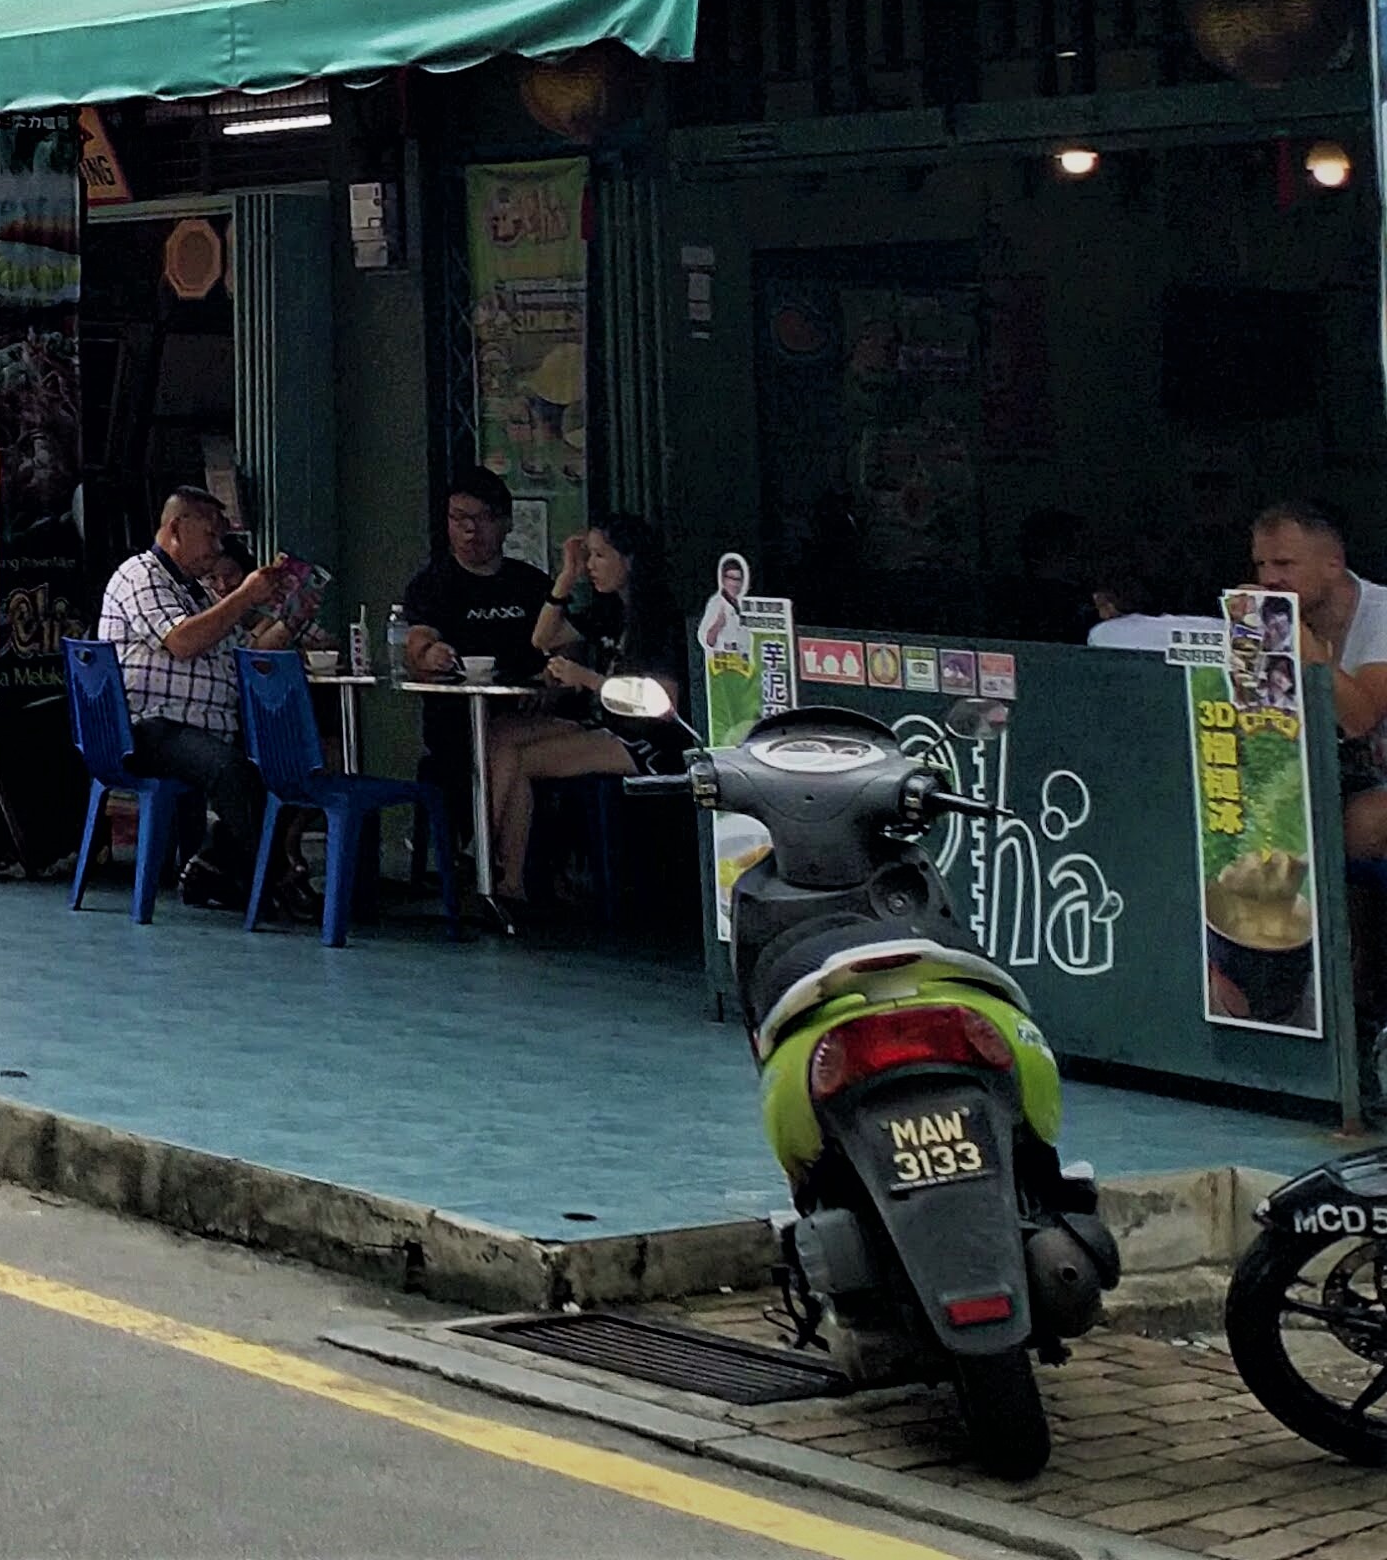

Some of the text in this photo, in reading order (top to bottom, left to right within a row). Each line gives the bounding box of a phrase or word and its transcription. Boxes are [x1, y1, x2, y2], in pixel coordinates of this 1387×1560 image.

[890, 1110, 964, 1149] MAW
[893, 1142, 983, 1181] 3133
[1293, 1203, 1368, 1234] MCD
